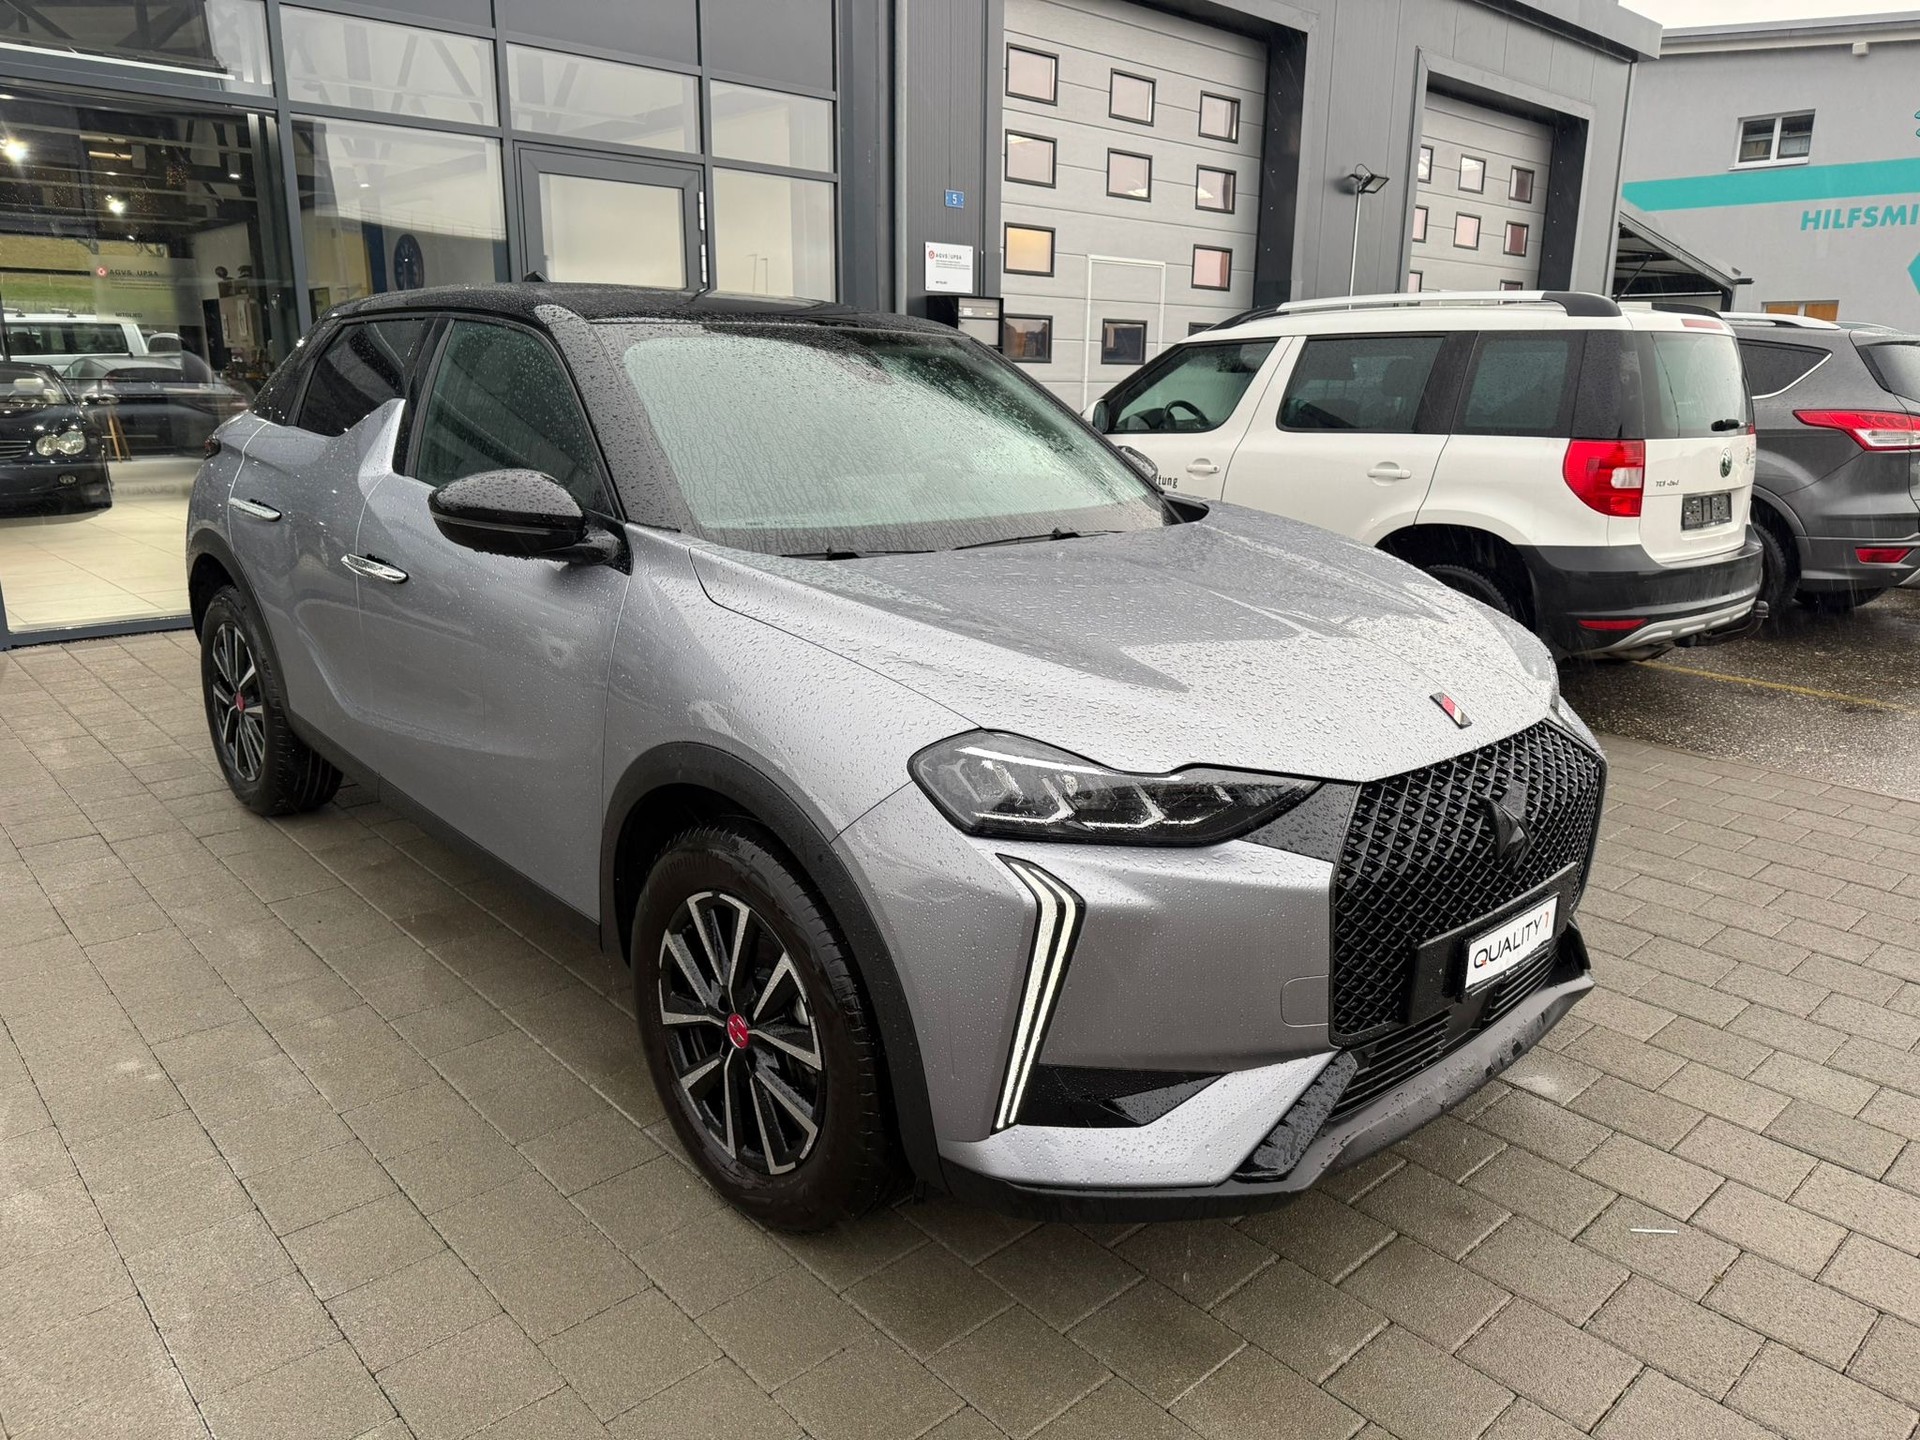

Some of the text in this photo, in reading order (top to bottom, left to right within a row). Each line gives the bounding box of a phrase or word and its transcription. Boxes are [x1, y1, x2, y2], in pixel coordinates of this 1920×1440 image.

[952, 194, 958, 205] 5
[1800, 203, 1919, 231] HILFSMI
[1158, 475, 1178, 489] tung
[1473, 914, 1543, 969] QUALITY
